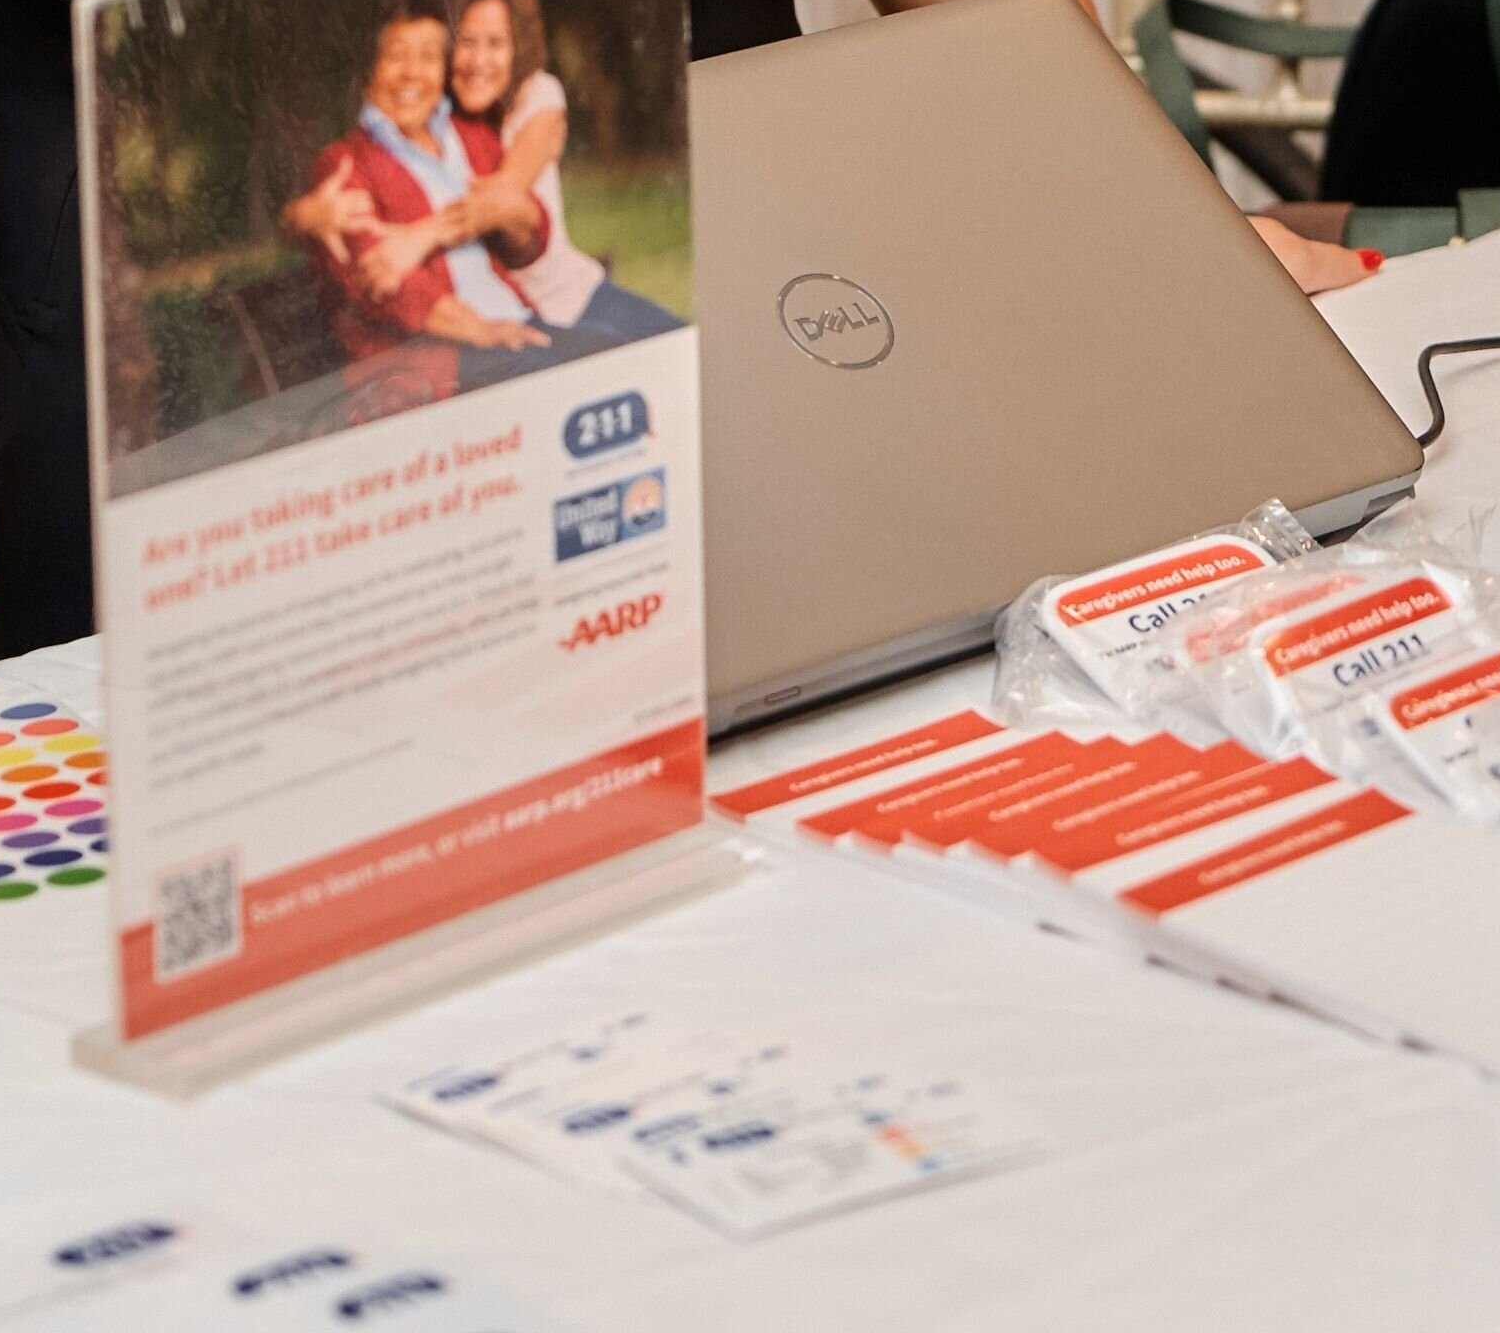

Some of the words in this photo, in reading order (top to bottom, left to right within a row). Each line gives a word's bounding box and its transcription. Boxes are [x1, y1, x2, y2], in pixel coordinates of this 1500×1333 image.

[793, 301, 881, 342] DELL
[195, 519, 246, 555] you
[250, 488, 335, 533] taking
[340, 469, 395, 506] care
[402, 449, 429, 484] of
[434, 452, 448, 475] a
[453, 423, 522, 467] loved
[558, 486, 621, 532] United
[314, 517, 372, 557] take
[376, 500, 433, 538] care
[437, 483, 465, 517] of
[577, 517, 620, 549] Way
[1066, 582, 1148, 619] Caregivers
[1146, 569, 1182, 594] need
[1181, 562, 1215, 580] help
[1213, 554, 1247, 572] too.
[568, 592, 665, 649] AARP
[1128, 601, 1178, 634] Call
[1273, 625, 1350, 666] Caregivers
[1347, 609, 1384, 635] need
[1380, 599, 1412, 625] help
[1332, 650, 1381, 688] Call
[1381, 633, 1430, 662] 211
